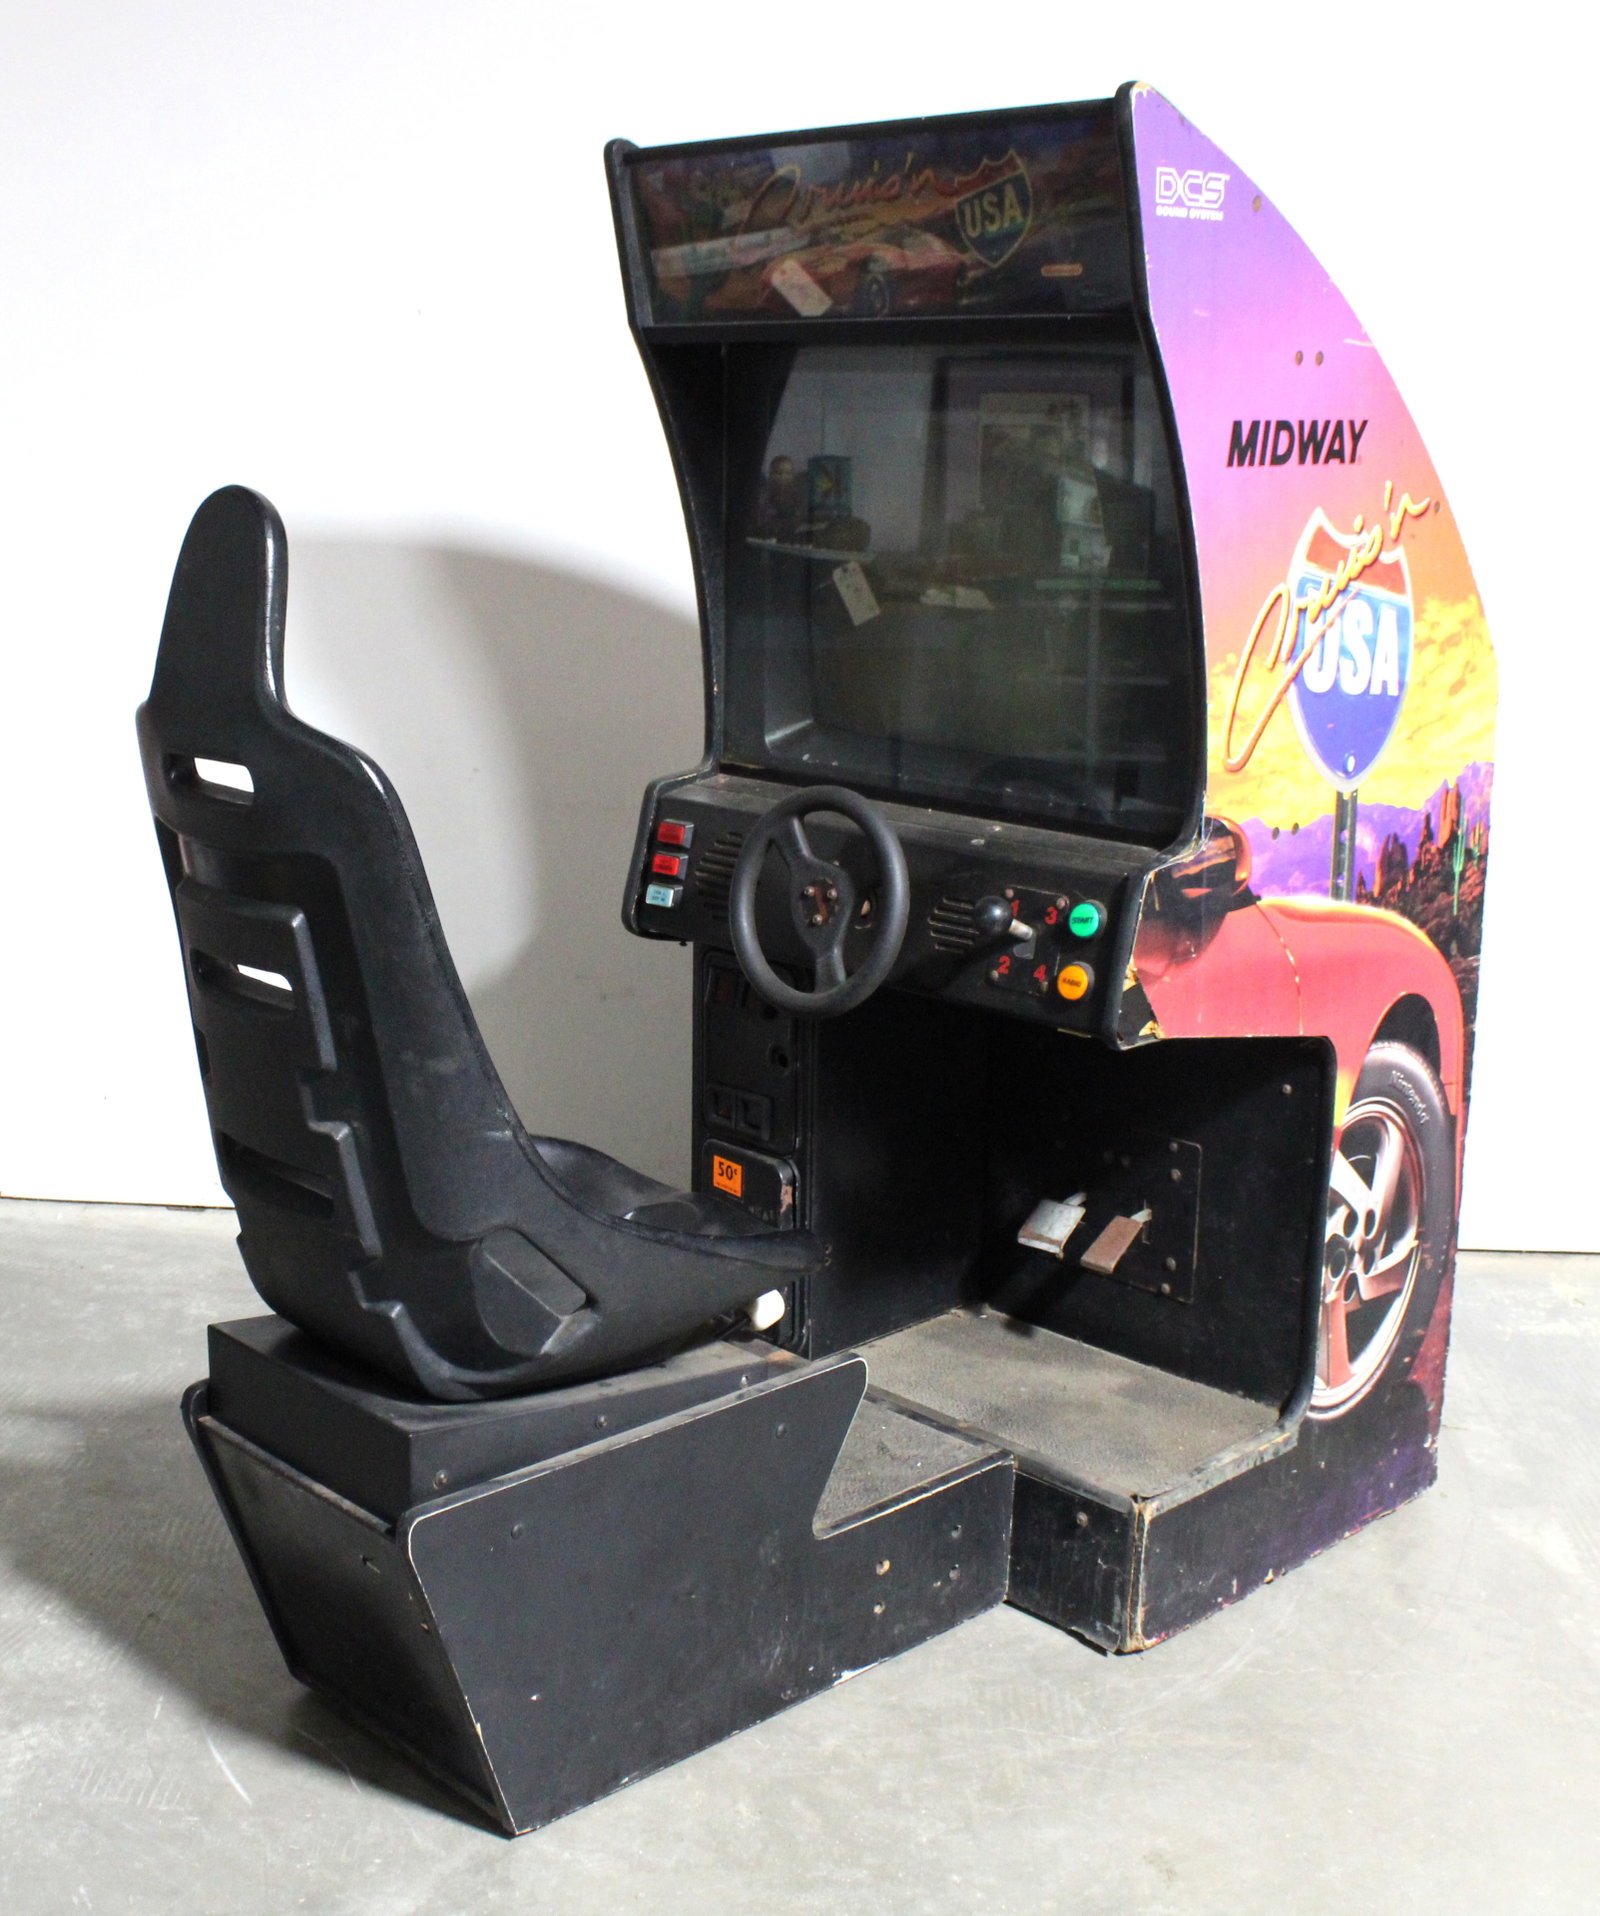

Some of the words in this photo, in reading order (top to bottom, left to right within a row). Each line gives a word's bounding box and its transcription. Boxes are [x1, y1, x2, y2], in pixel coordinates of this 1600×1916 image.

[1155, 166, 1231, 209] DCS
[962, 183, 1024, 239] USA
[1226, 419, 1369, 468] MIDWAY
[1302, 584, 1400, 697] USA
[1011, 900, 1020, 916] 1
[1045, 906, 1058, 924] 3
[1071, 916, 1094, 925] START
[997, 955, 1011, 974] 2
[1033, 964, 1047, 982] 4
